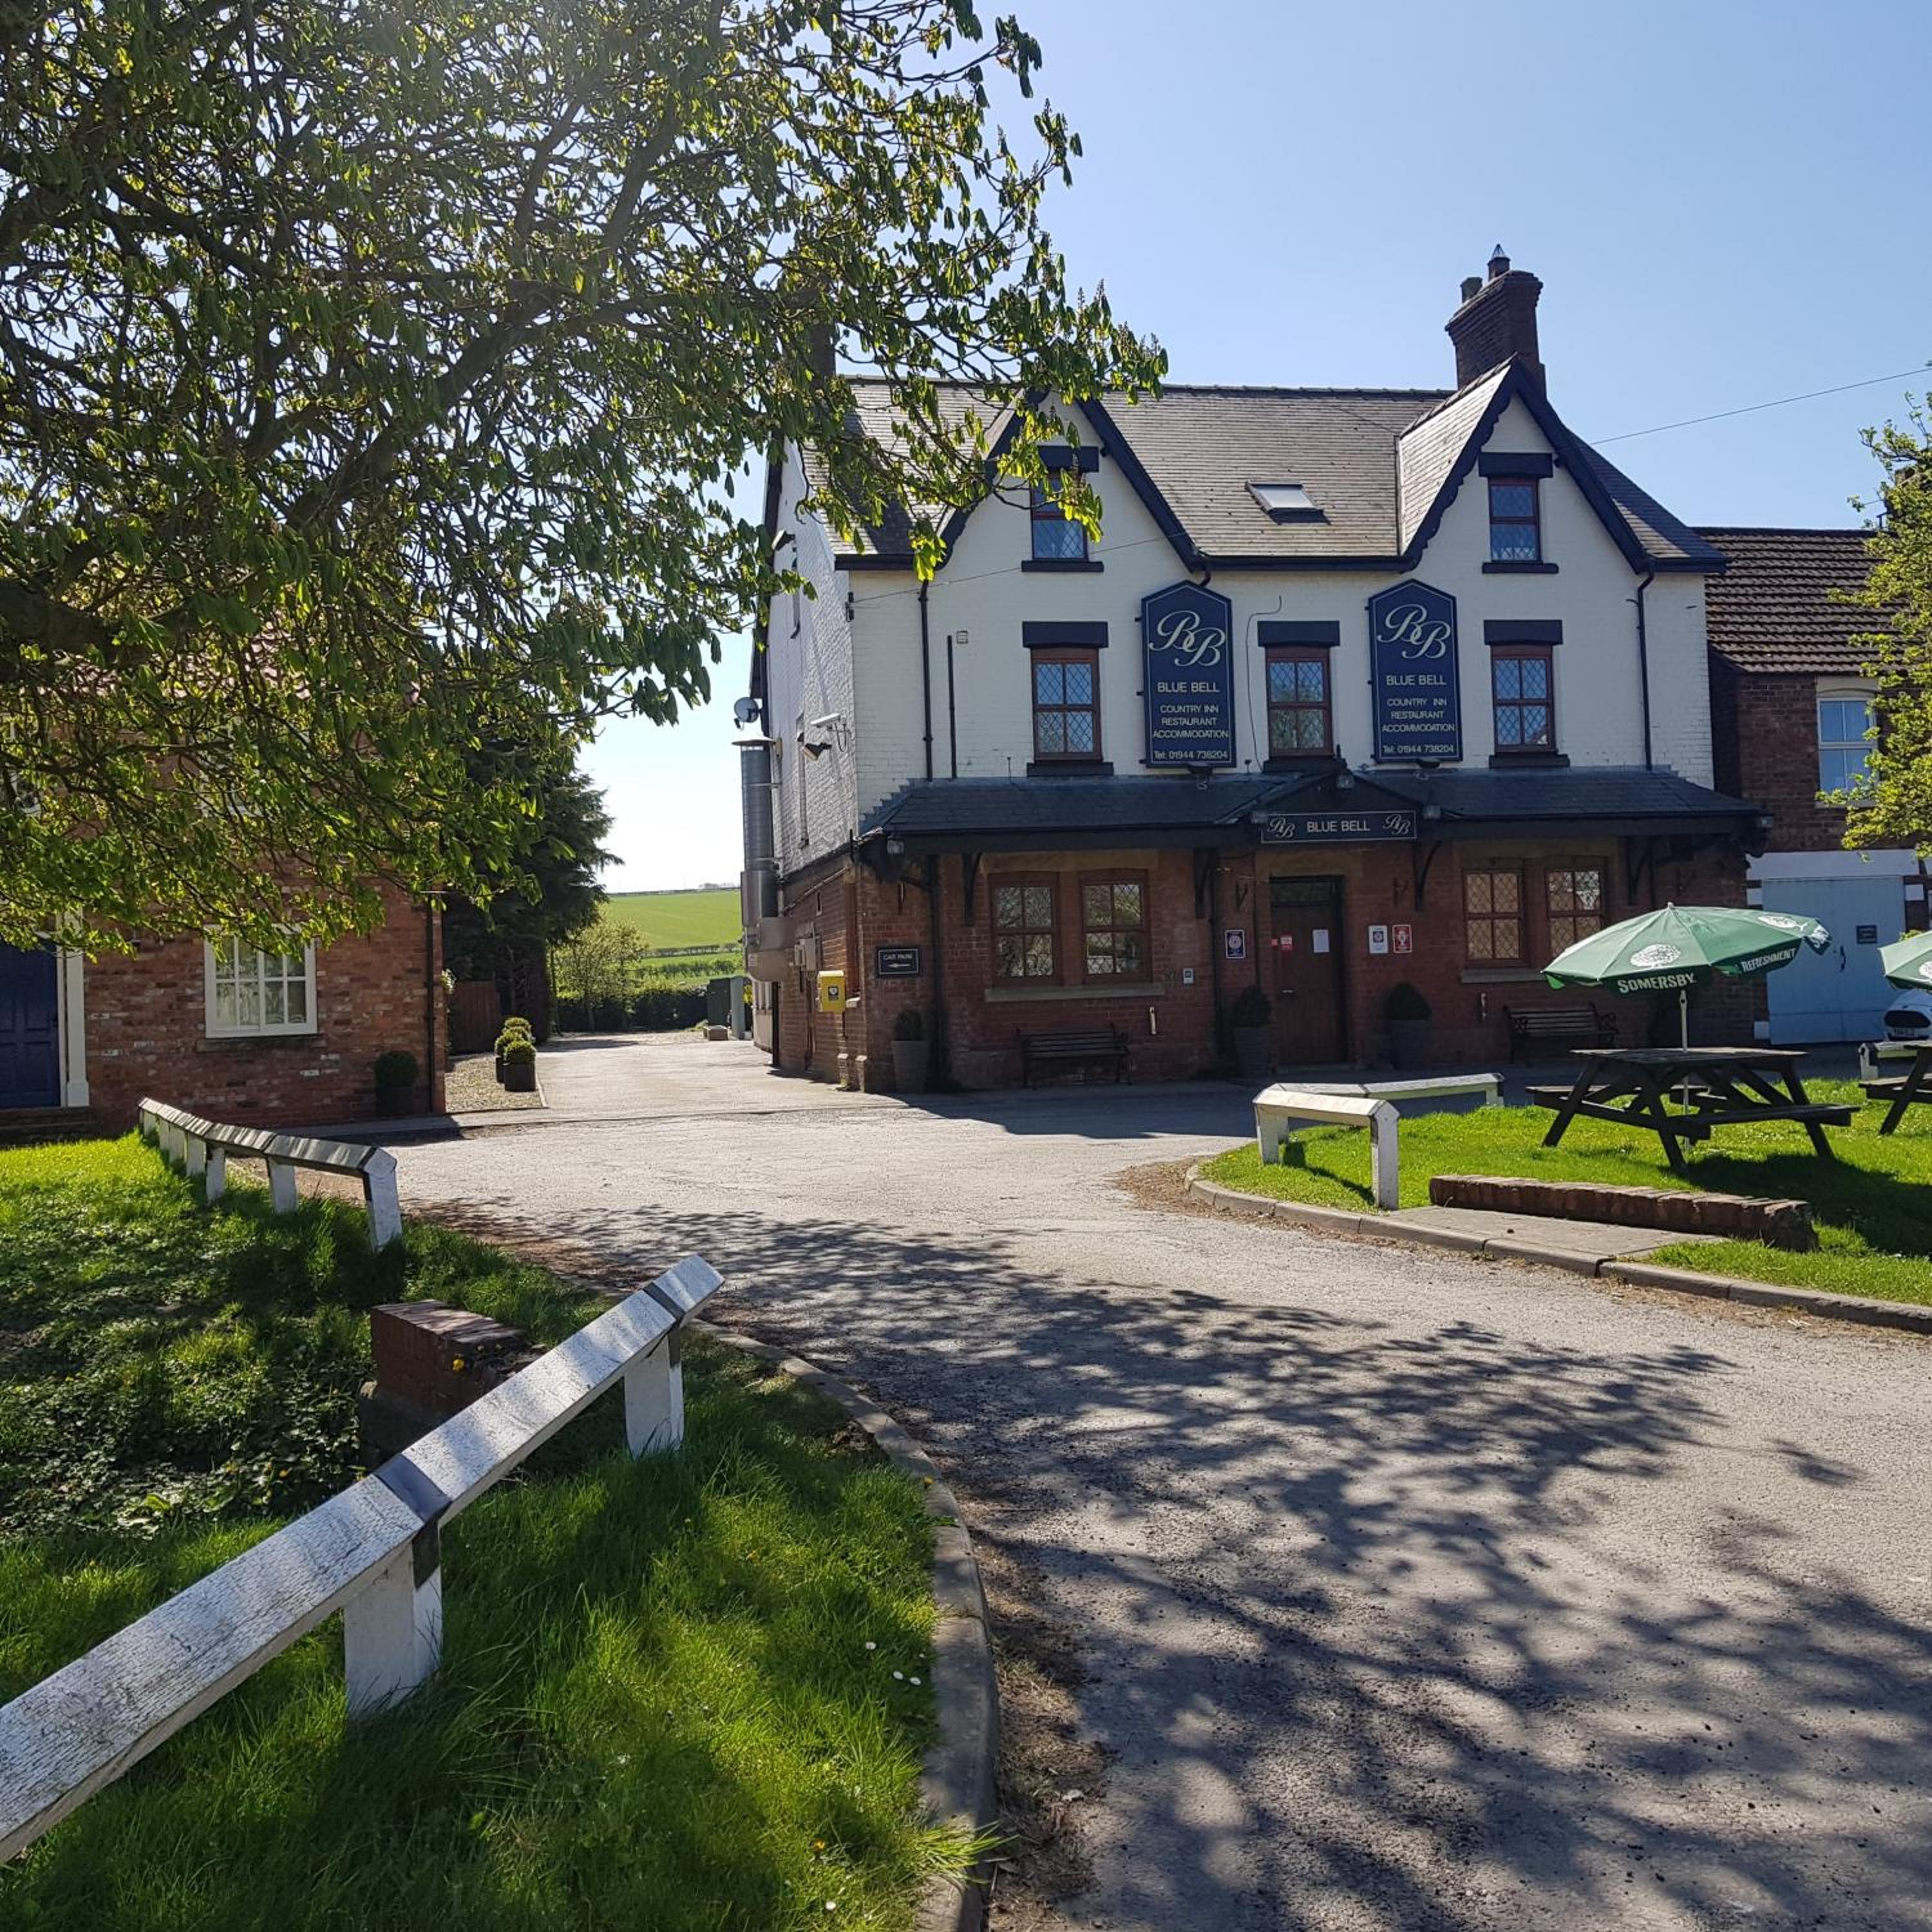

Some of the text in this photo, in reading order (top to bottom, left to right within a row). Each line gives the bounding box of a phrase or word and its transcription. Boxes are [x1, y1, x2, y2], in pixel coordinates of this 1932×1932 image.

[1387, 674, 1447, 685] BLUE BELL
[1157, 681, 1220, 692] BLUE BELL
[1387, 697, 1447, 706] COUNTRY INN
[1160, 705, 1219, 714] COUNTRY INN
[1391, 710, 1444, 719] RESTAURANT
[1161, 717, 1217, 726] RESTAURANT
[1381, 723, 1455, 732] ACCOMMODATION
[1153, 730, 1229, 739] ACCOMMODATION
[1169, 750, 1193, 759] 01944
[1196, 750, 1227, 759] 738204
[1307, 820, 1370, 833] BLUE BELL
[1741, 947, 1796, 972] REFRESHMENT
[1617, 972, 1696, 994] SOMERSBY
